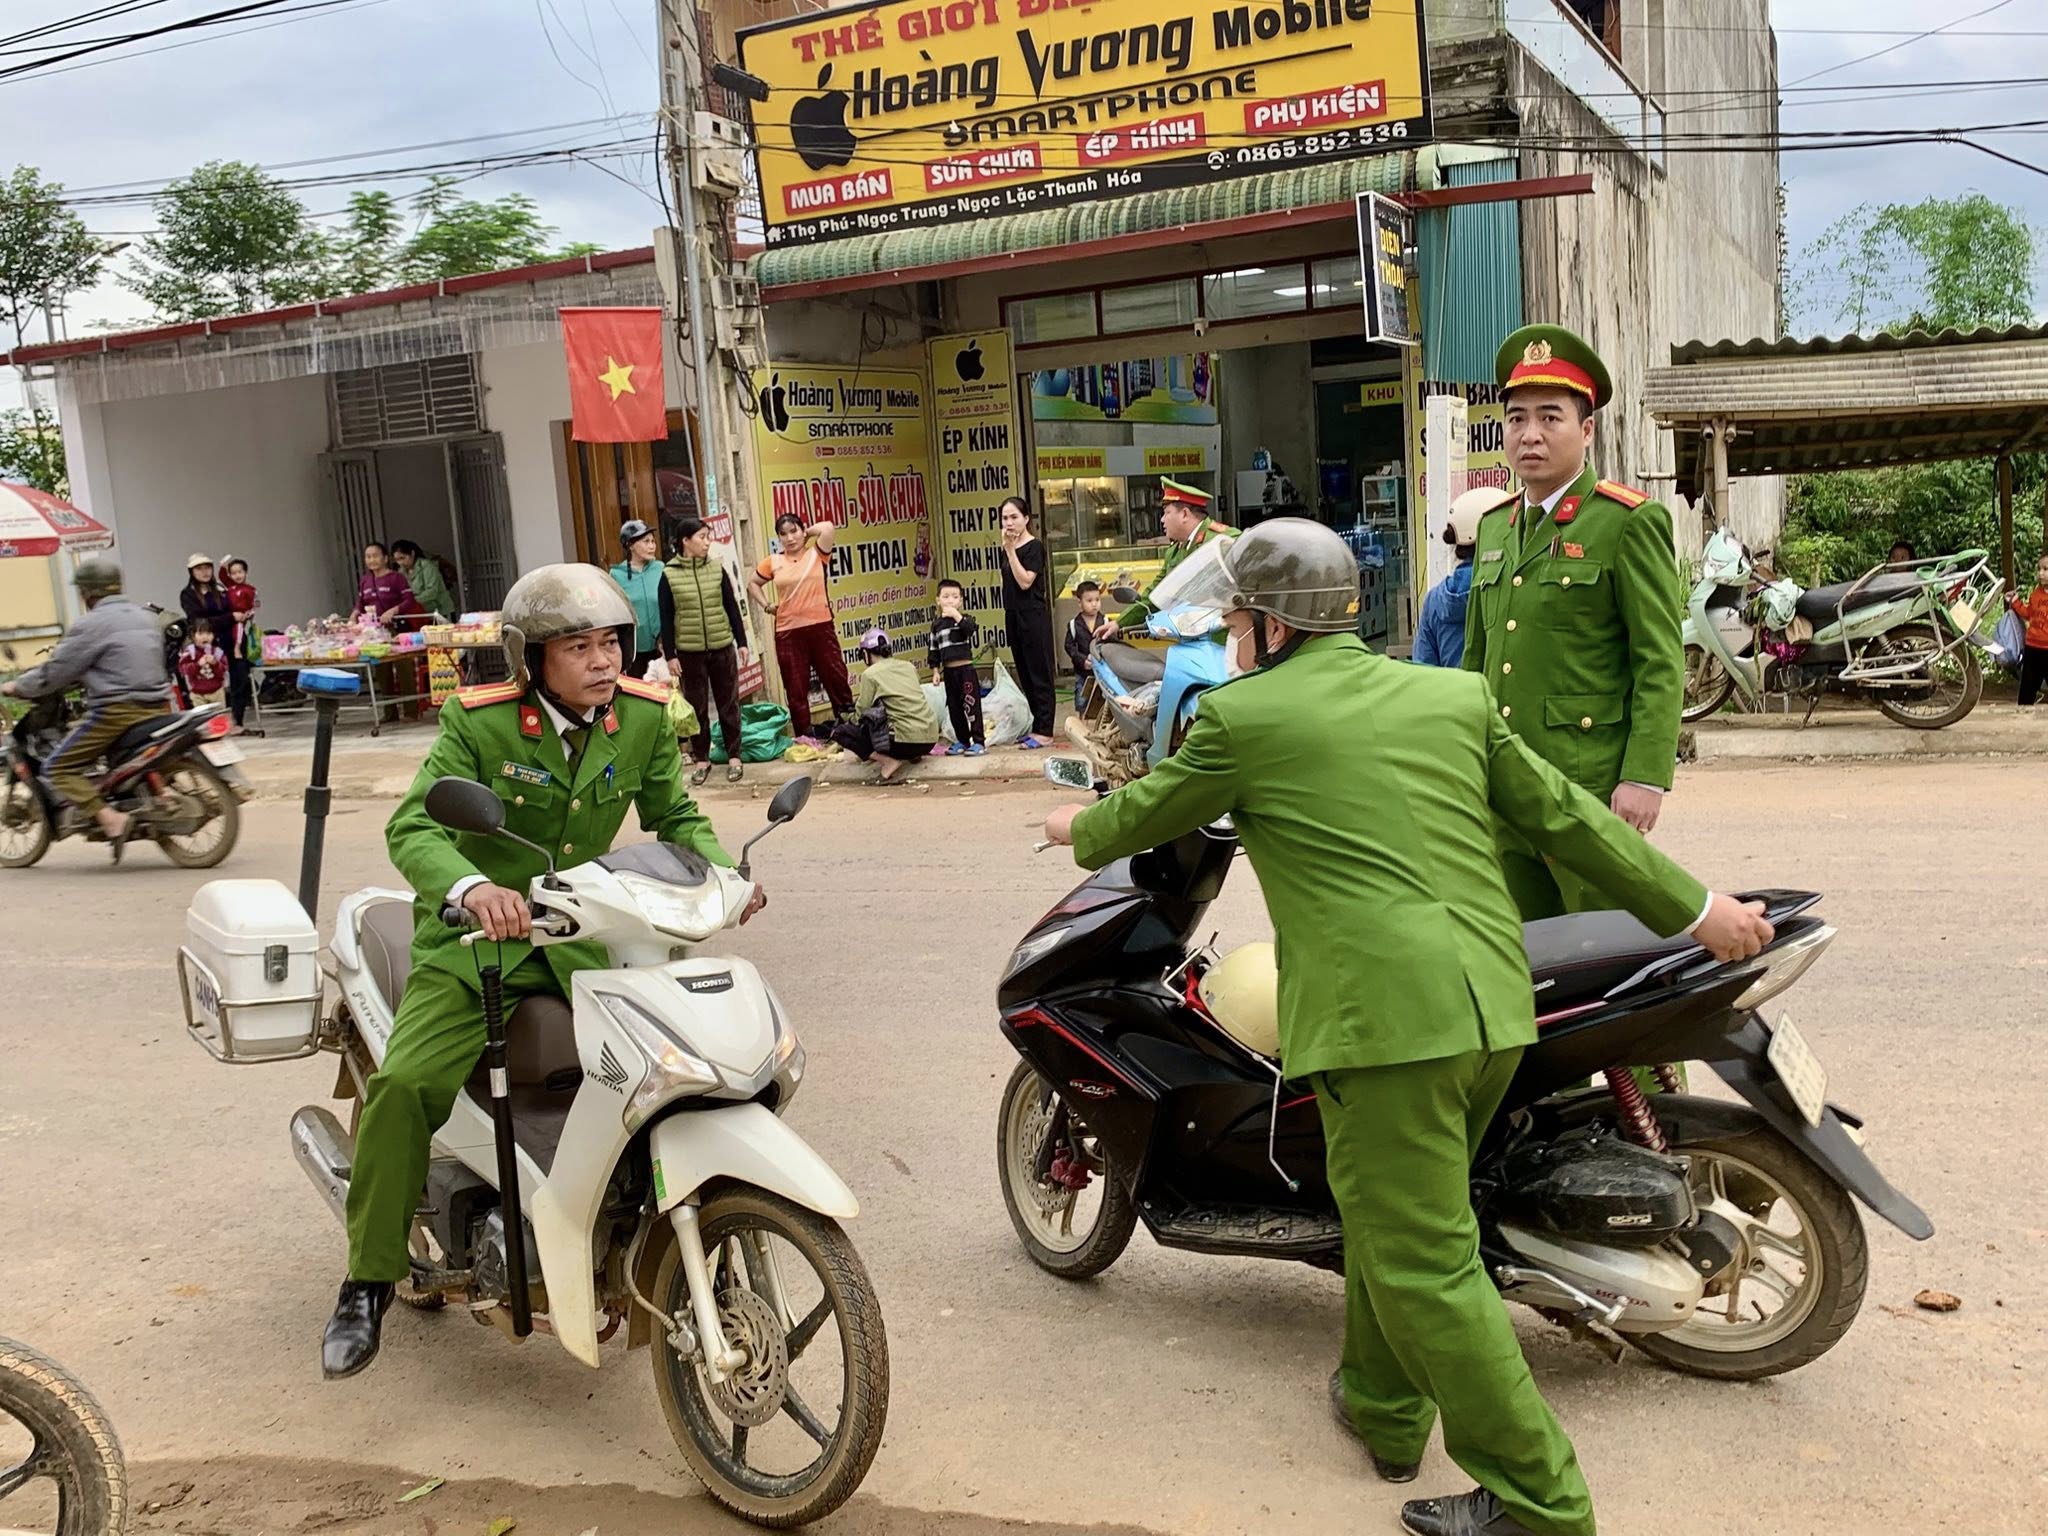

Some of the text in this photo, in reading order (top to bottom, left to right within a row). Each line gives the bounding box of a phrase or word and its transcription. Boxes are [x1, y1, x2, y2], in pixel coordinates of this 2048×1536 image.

[792, 8, 884, 63] THẾ
[853, 0, 1372, 120] Hoàng Vương Mobile
[1254, 85, 1380, 127] PHỤ KIỆN
[1085, 117, 1196, 158] ÉP KÍNH
[790, 172, 888, 210] MUA BÁN
[1106, 169, 1142, 188] Hóa
[788, 378, 920, 413] Hoàng Vương Mobile
[1367, 386, 1395, 401] KHU
[942, 422, 1009, 454] ÉP KÍNH
[1467, 414, 1505, 453] HỮA
[948, 459, 1009, 494] CẢM ỨNG
[772, 480, 813, 529] MUA
[949, 508, 984, 533] THAY
[857, 538, 908, 575] THOẠI
[953, 544, 982, 572] MÀN
[837, 595, 856, 613] phụ
[859, 589, 879, 608] kiện
[882, 585, 902, 604] điện
[904, 584, 927, 600] thoại
[842, 620, 854, 639] TAI
[892, 635, 912, 654] MÀN
[691, 978, 732, 990] HONDA
[586, 1068, 625, 1096] HONDA
